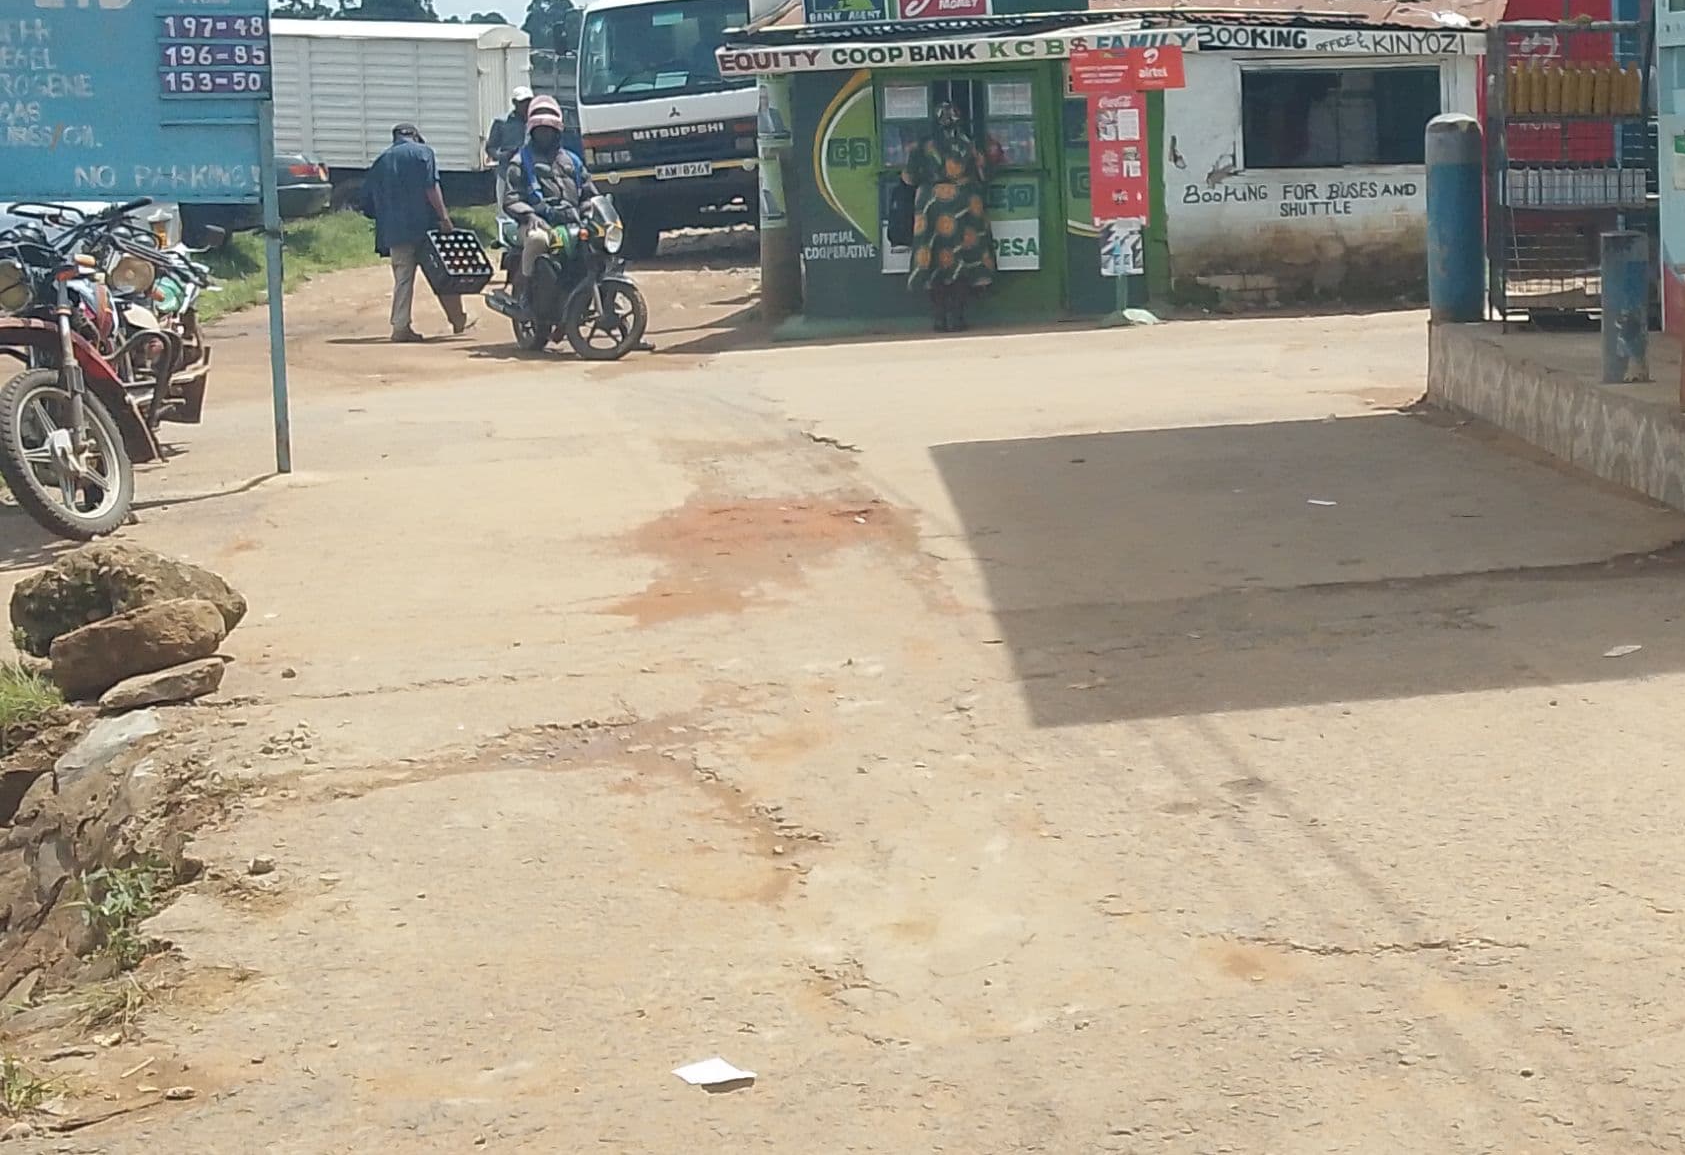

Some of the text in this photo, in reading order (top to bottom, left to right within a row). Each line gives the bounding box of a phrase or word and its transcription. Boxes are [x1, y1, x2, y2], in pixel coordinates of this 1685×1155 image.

[164, 16, 264, 38] 197-48
[809, 10, 881, 23] BANK AGENT
[1198, 25, 1308, 49] BOOKING
[1316, 35, 1355, 52] OFFICE
[1372, 32, 1466, 55] KINYOZI
[165, 45, 266, 67] 196-85
[719, 48, 821, 72] EQUITY
[831, 46, 904, 65] COOP
[910, 43, 976, 63] BANK
[1096, 32, 1193, 50] FAMILY
[165, 72, 262, 92] 153-50
[75, 165, 116, 188] NO
[1283, 183, 1319, 200] FOR
[1326, 181, 1378, 200] BUSES
[1382, 182, 1417, 196] AND
[1280, 202, 1353, 217] SHUTTLE
[812, 230, 855, 244] OFFICIAL
